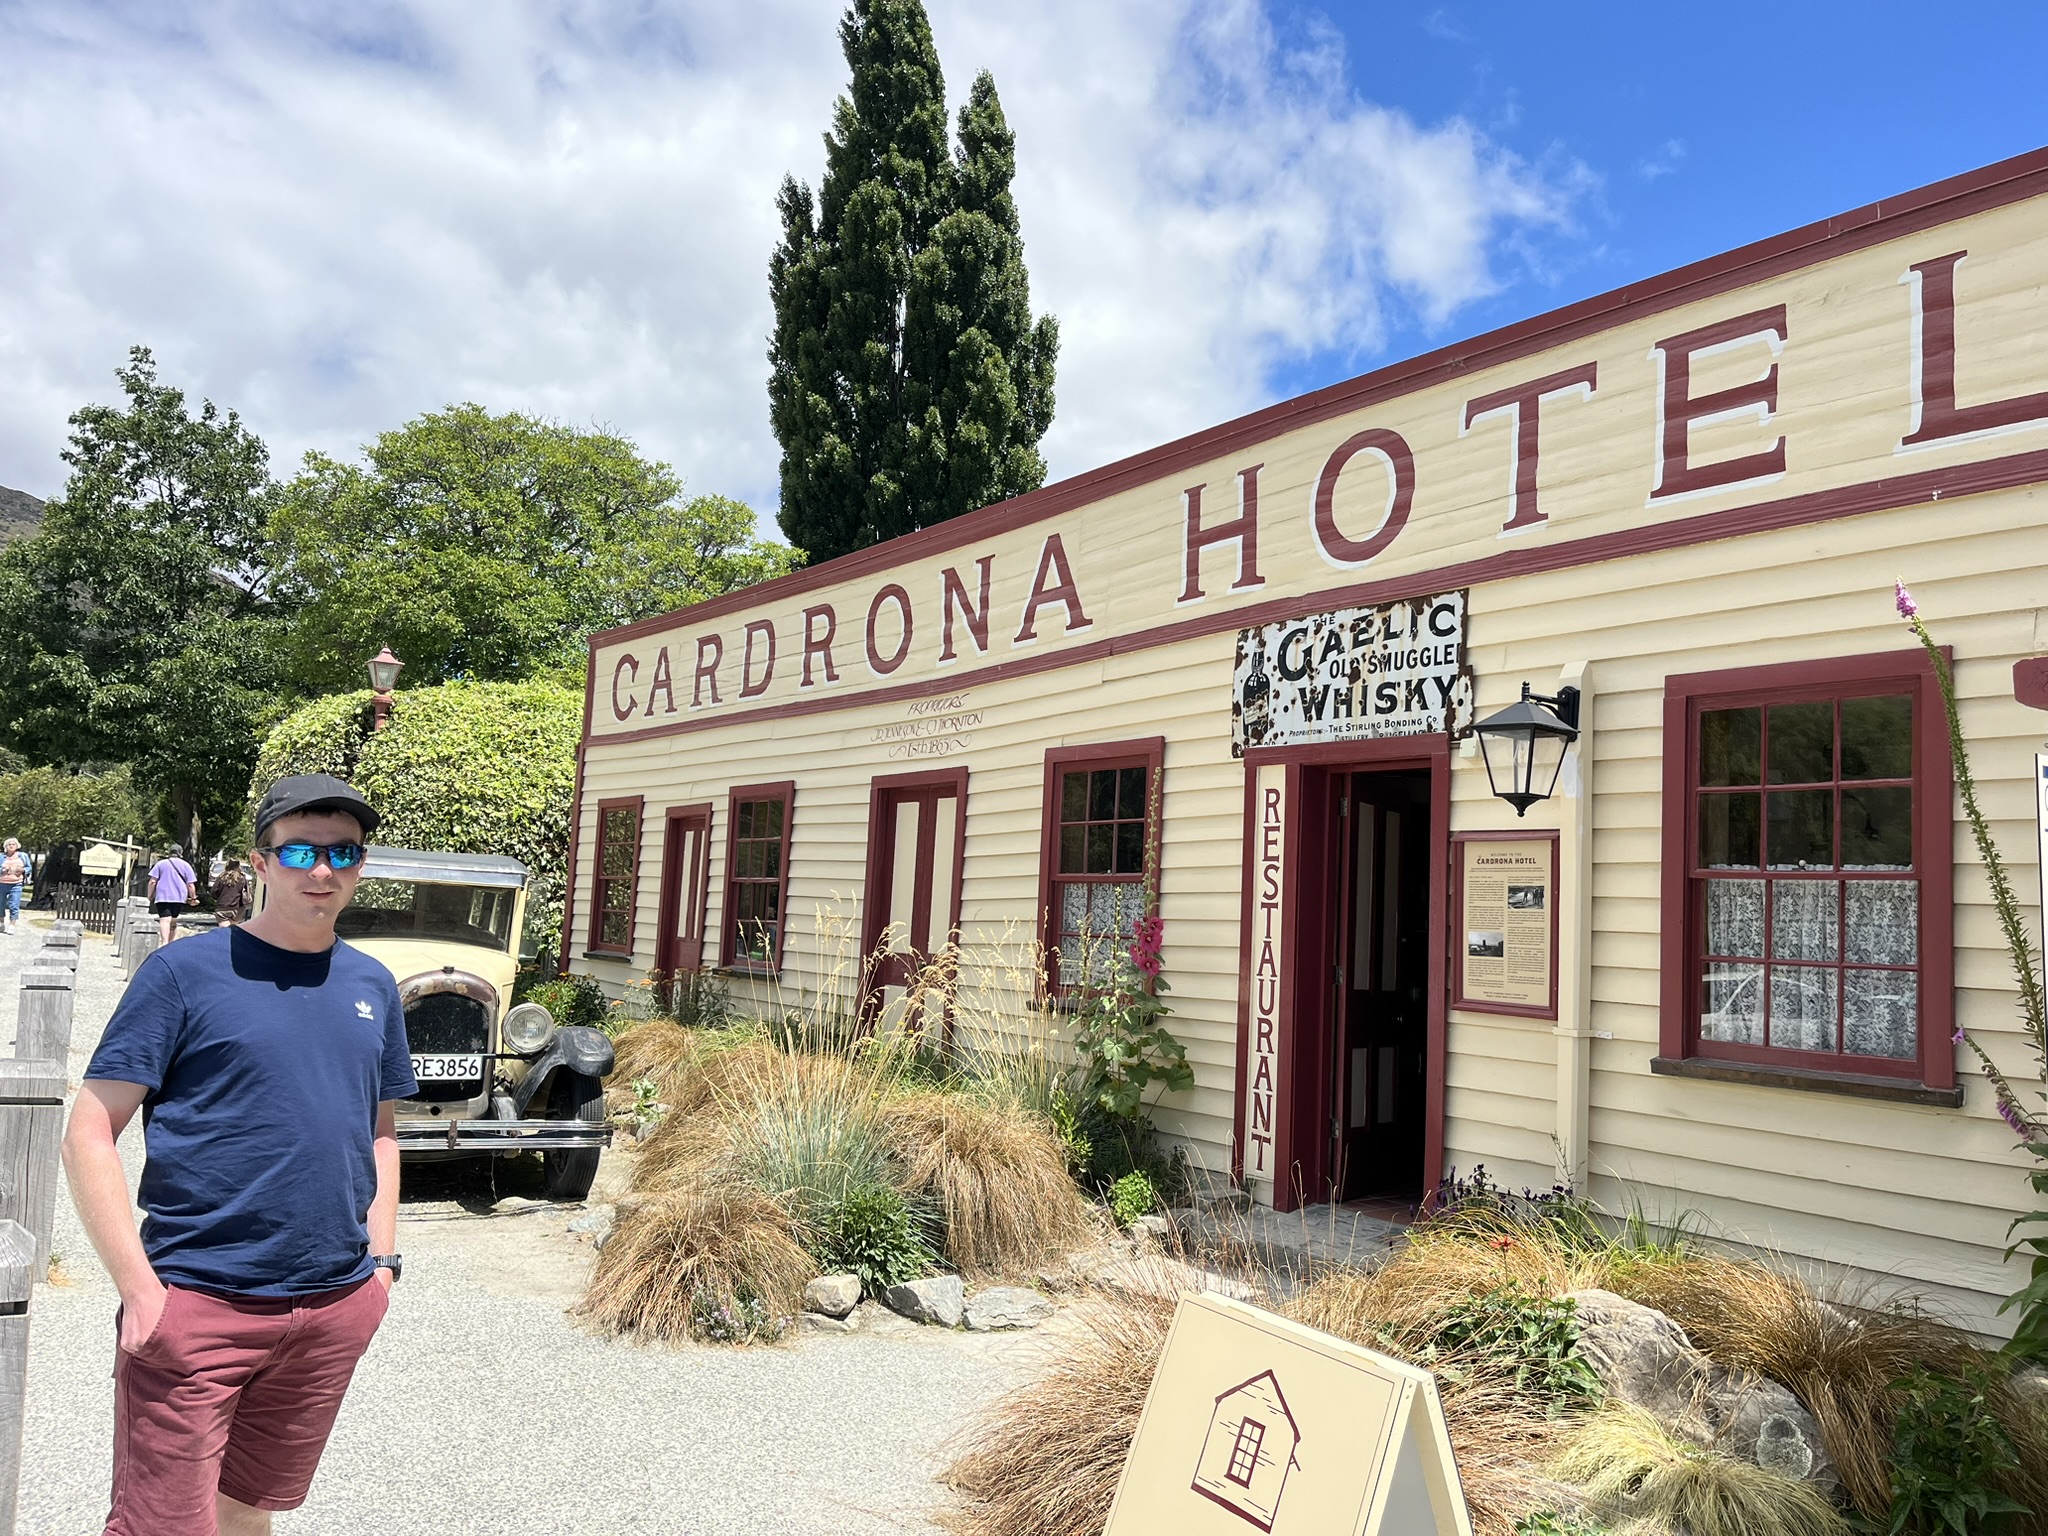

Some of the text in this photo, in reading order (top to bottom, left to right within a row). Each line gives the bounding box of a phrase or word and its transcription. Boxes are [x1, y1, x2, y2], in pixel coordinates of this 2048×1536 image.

[612, 249, 2048, 722] CARDRONA HOTEL
[1313, 616, 1336, 627] THE
[1277, 603, 1457, 682] GAELIC
[1297, 674, 1458, 722] WHISKY
[1329, 724, 1343, 733] THE
[1345, 721, 1381, 732] STIRLING
[1384, 718, 1423, 729] BONDING
[1477, 857, 1513, 865] CARDRONA
[1250, 788, 1281, 1172] RESTAURANT
[411, 1058, 479, 1077] RE3856
